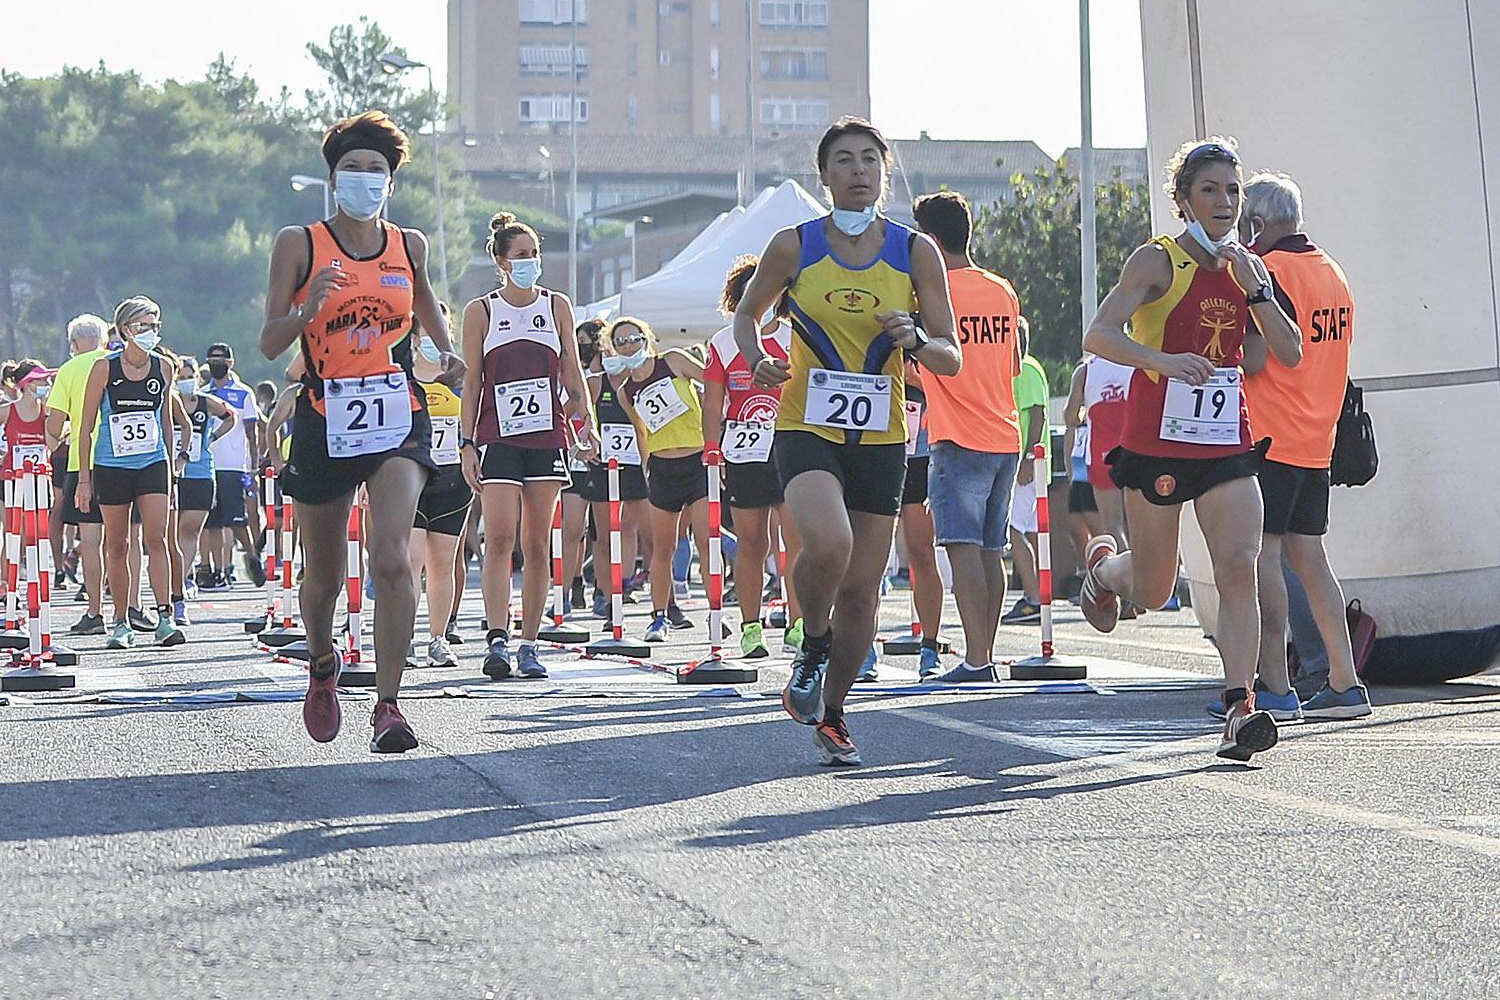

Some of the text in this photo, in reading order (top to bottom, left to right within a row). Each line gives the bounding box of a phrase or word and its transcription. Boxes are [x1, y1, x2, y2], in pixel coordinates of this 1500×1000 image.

[1200, 298, 1237, 315] ATLETICA
[959, 316, 1010, 344] STAFF
[346, 398, 384, 430] 21
[510, 394, 540, 417] 26
[645, 393, 668, 415] 31
[826, 393, 872, 426] 20
[1191, 389, 1226, 419] 19
[122, 423, 147, 441] 35
[611, 435, 634, 450] 37
[734, 432, 760, 448] 29
